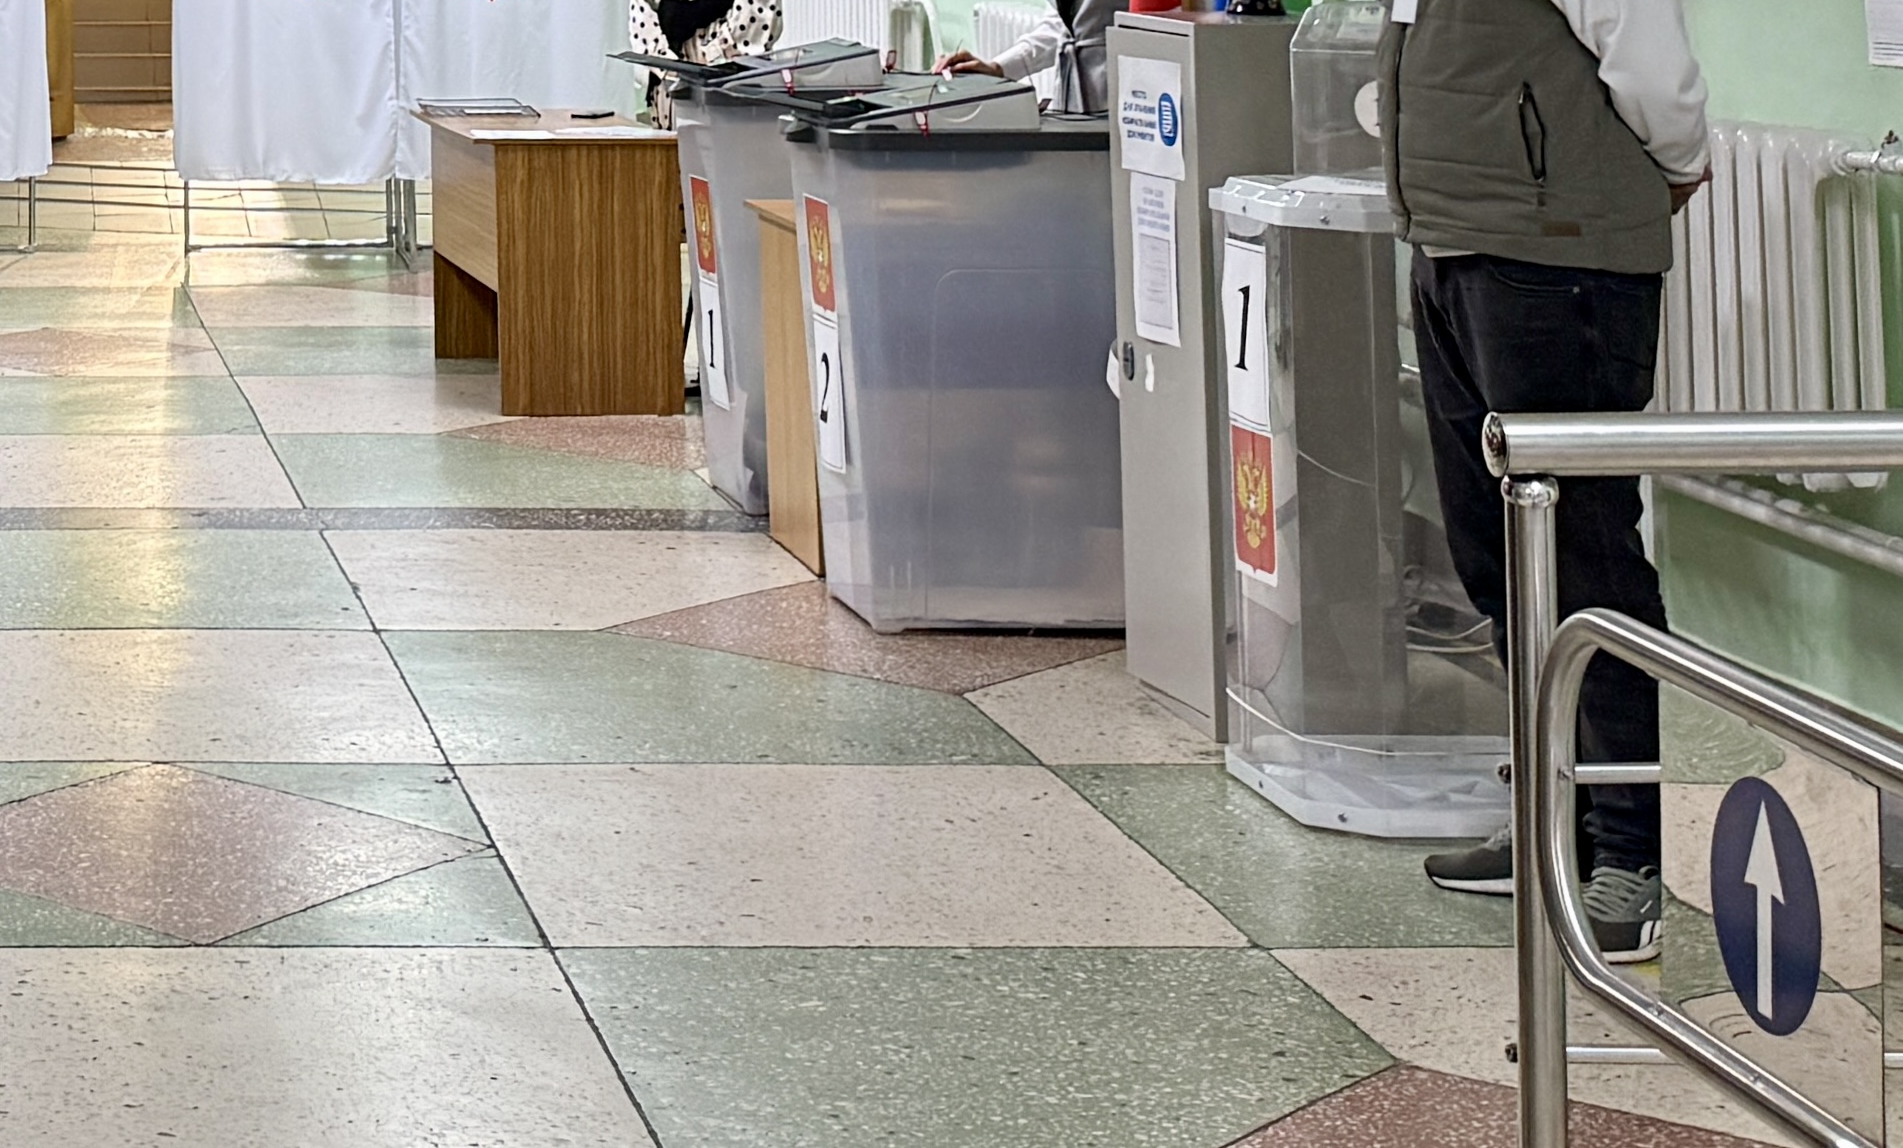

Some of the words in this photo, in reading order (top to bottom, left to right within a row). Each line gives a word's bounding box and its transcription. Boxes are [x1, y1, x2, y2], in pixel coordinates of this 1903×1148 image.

[707, 309, 716, 368] 1
[1234, 285, 1250, 371] 1
[819, 352, 830, 423] 2
